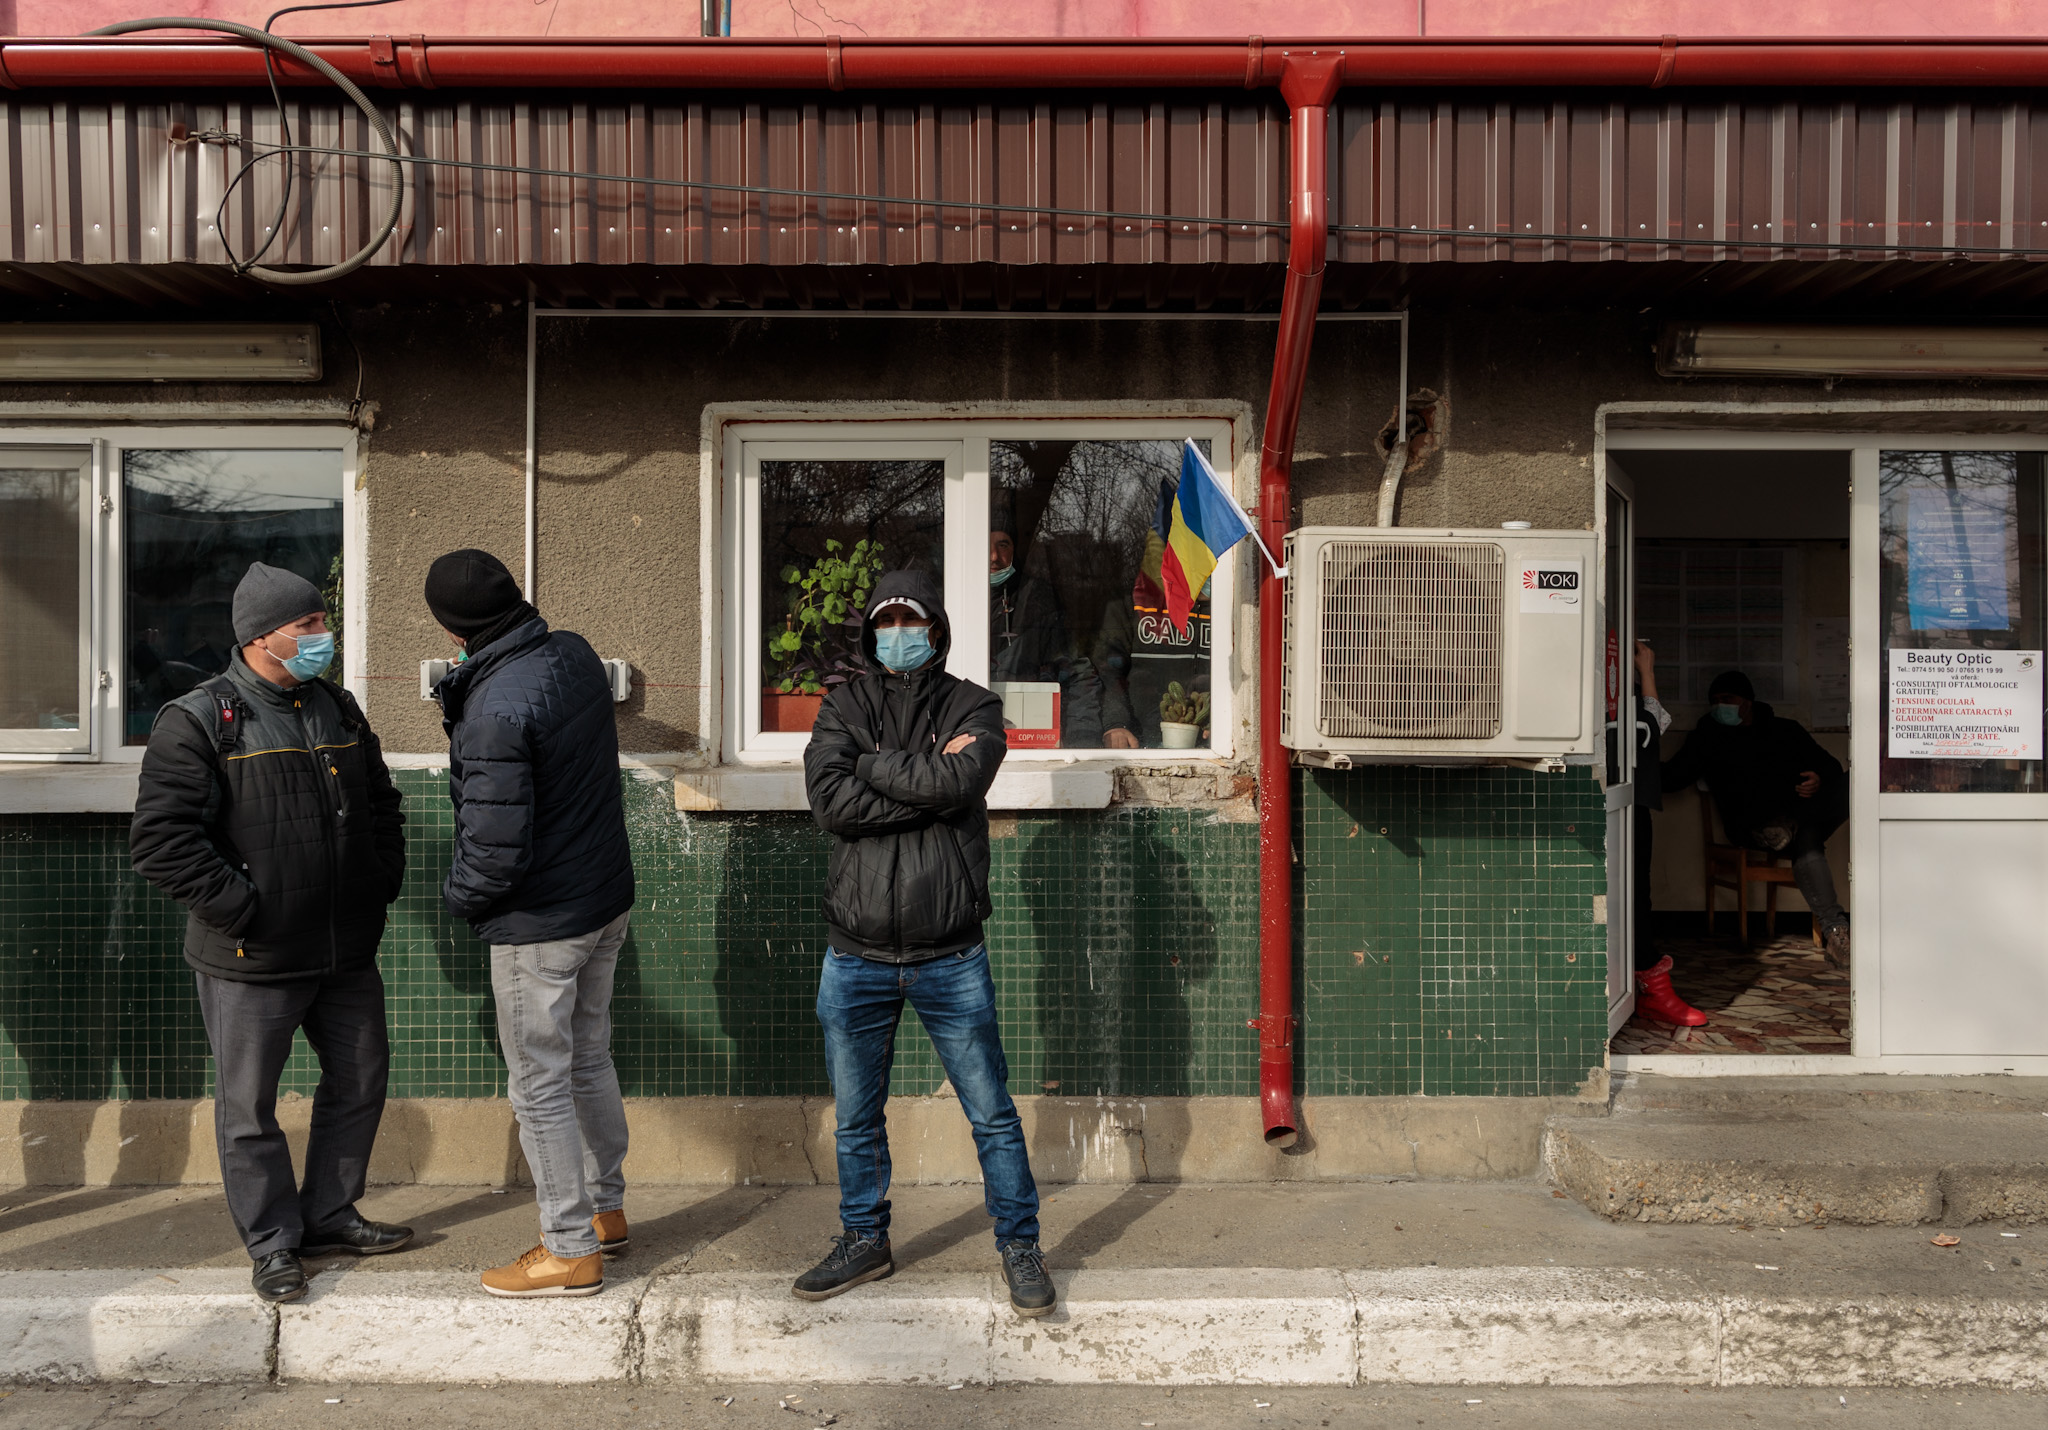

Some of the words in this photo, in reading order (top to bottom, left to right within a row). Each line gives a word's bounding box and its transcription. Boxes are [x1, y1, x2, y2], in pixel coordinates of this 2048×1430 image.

[1540, 573, 1576, 587] YOKI
[1907, 652, 1952, 666] Beauty
[1956, 653, 1992, 666] Optic
[1948, 681, 2019, 689] OFTALMOLOGICE
[1937, 697, 1975, 705] OCULARĂ
[1896, 707, 1954, 715] DETERMINARE
[1955, 708, 2003, 716] CATARACTĂ
[1018, 733, 1035, 741] COPY
[1036, 733, 1056, 741] PAPER
